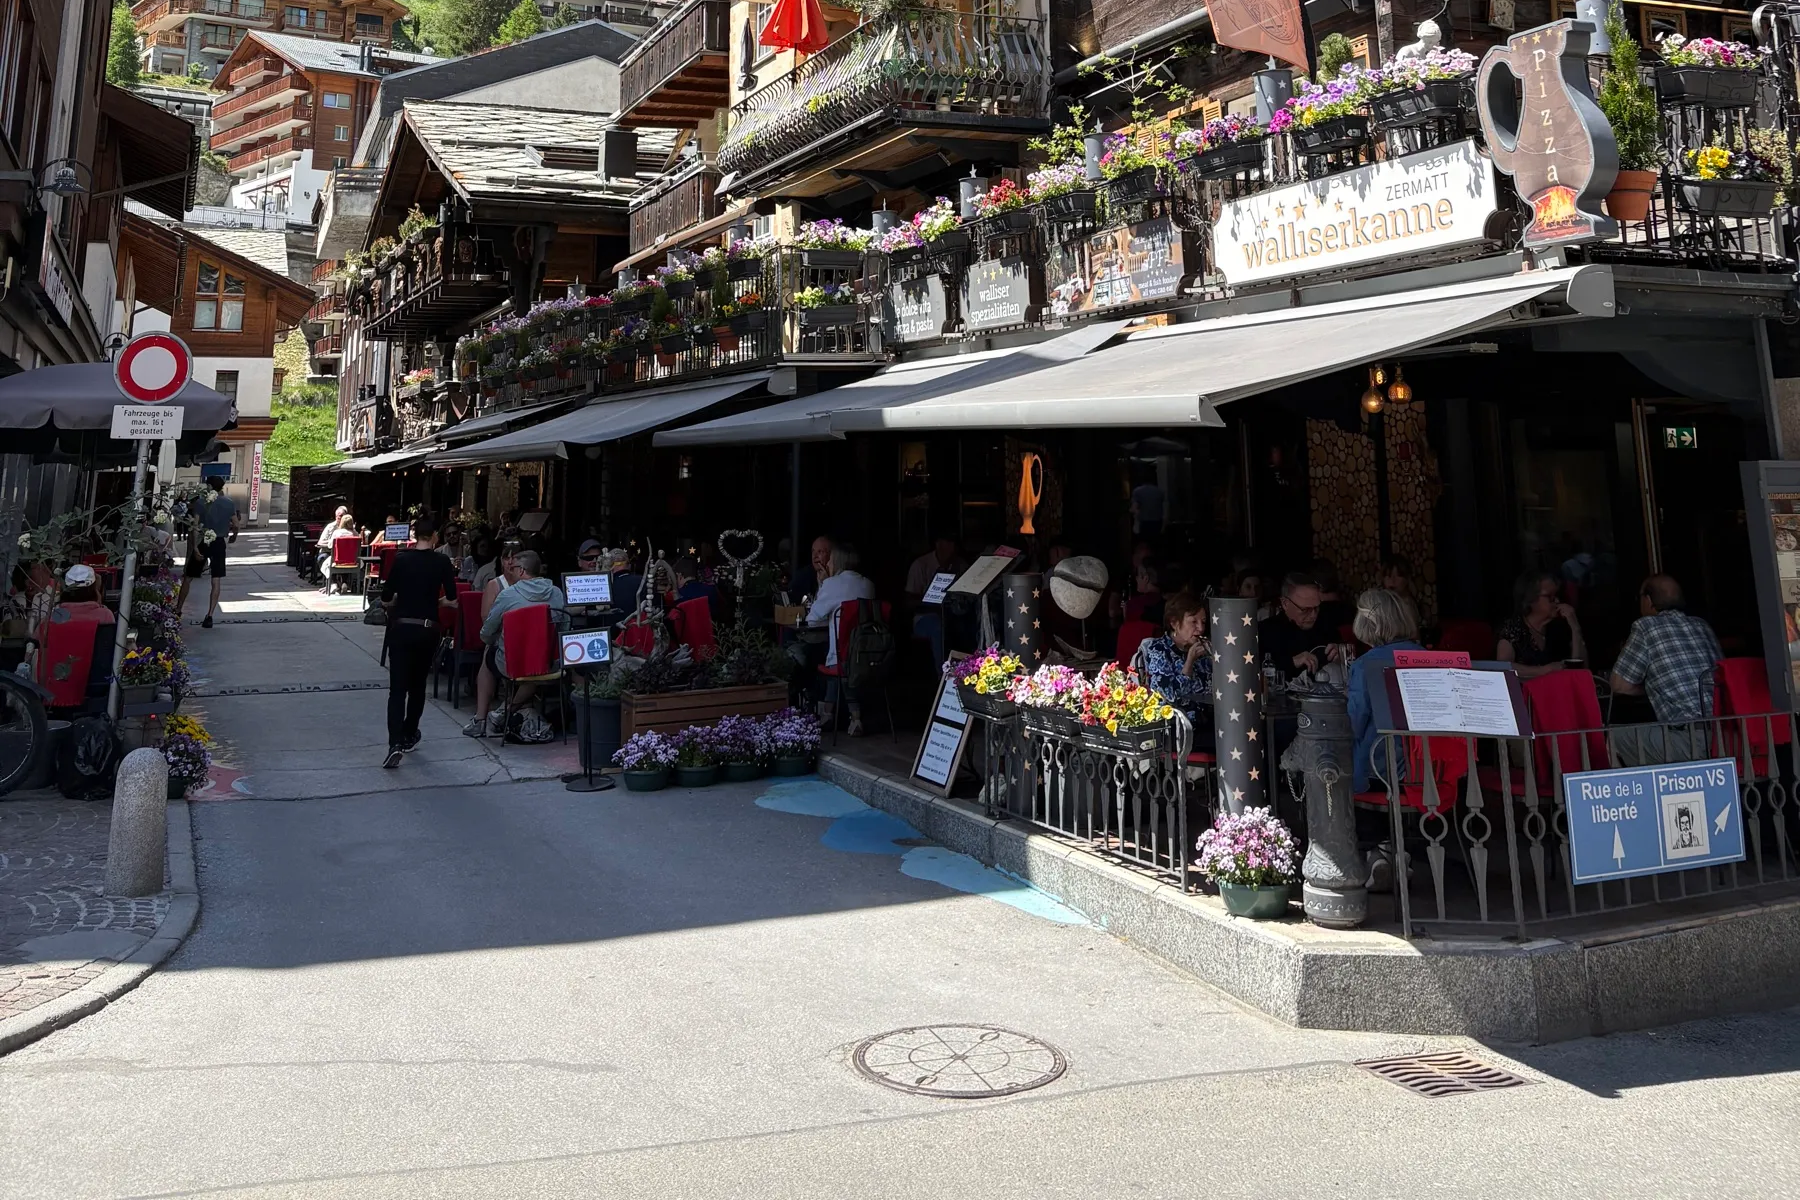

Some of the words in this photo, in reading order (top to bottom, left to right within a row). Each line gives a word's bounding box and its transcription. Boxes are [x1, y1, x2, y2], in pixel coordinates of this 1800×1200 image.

[1532, 49, 1559, 183] Pizza
[1385, 171, 1450, 201] ZERMATT
[1242, 198, 1455, 269] walliserkanne
[979, 284, 1010, 302] walliser
[901, 301, 918, 317] dolce
[971, 301, 1020, 325] spezialitäten
[916, 317, 934, 335] pasta
[123, 409, 160, 418] Fahrzeuge
[130, 428, 163, 436] gestattet
[251, 477, 259, 512] OCHSNER
[565, 632, 603, 640] PRIVATSTRASSE
[1581, 782, 1611, 800] Rue
[1615, 783, 1630, 797] de
[1632, 780, 1643, 796] la
[1658, 773, 1704, 792] Prison
[1706, 768, 1726, 787] VS
[1591, 801, 1638, 823] liberté
